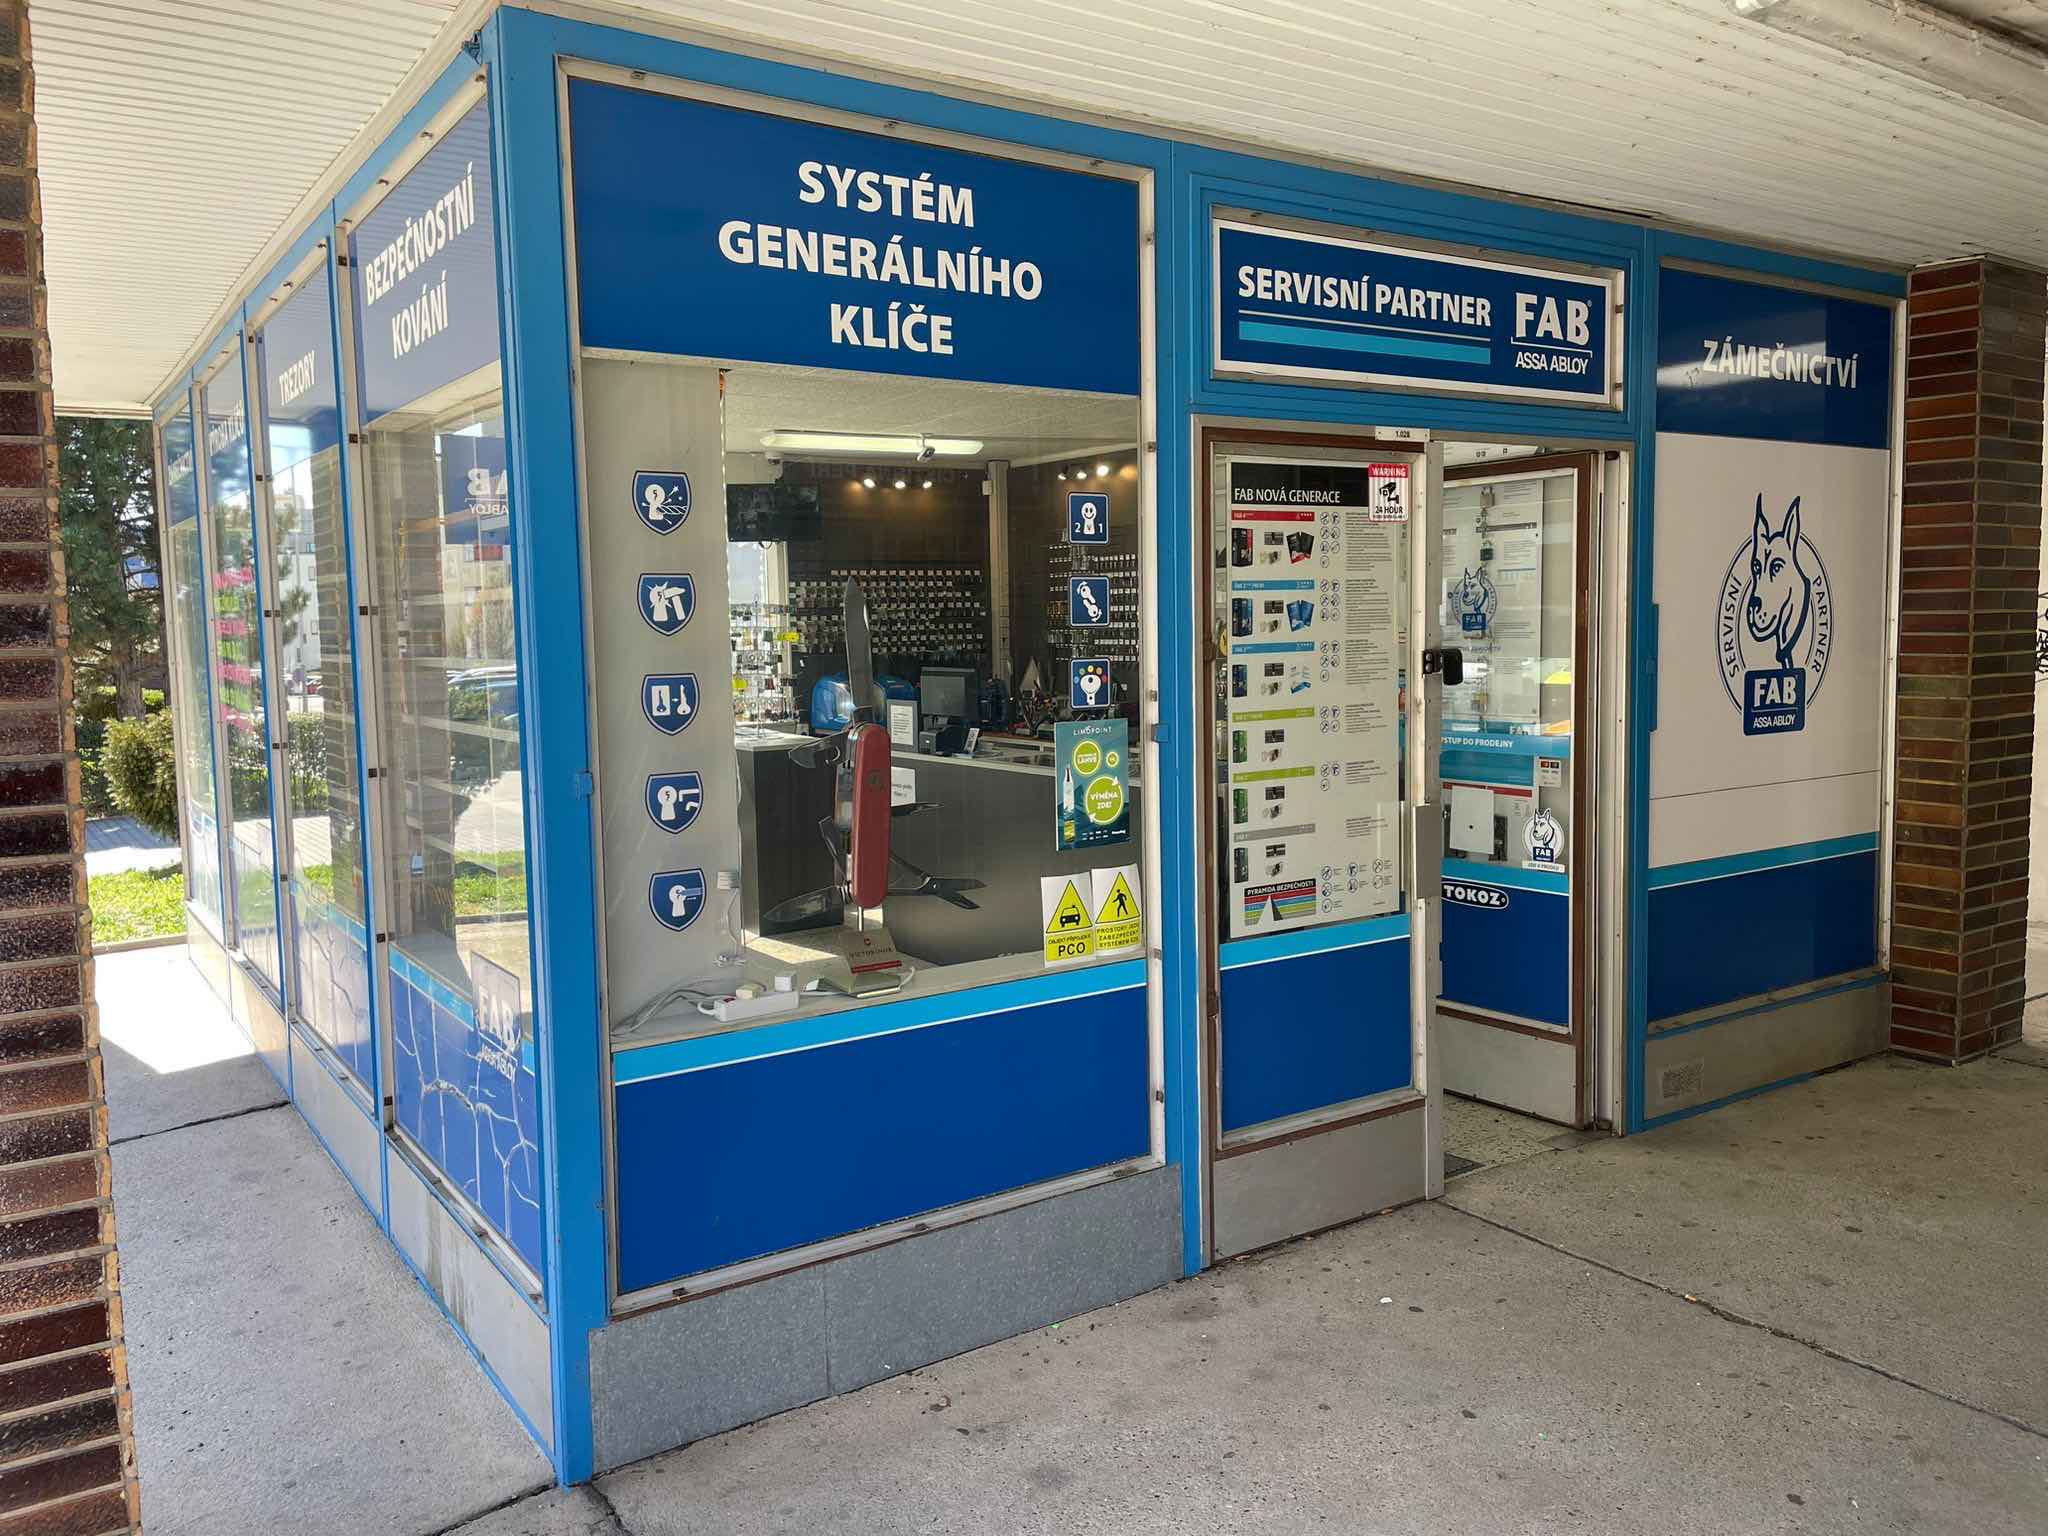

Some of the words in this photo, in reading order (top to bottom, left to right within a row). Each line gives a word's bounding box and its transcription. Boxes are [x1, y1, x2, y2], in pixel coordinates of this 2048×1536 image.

[798, 161, 974, 228] SYSTÉM
[365, 161, 475, 306] BEZPEČNOSTNÍ
[718, 220, 1043, 300] GENERÁLNÍHO
[391, 270, 449, 359] KOVÁNÍ
[1238, 265, 1370, 312] SERVISNÍ
[1375, 286, 1491, 327] PARTNER
[1515, 292, 1590, 345] FAB
[830, 302, 954, 355] KLÍČE
[279, 350, 316, 406] TREZORY
[1515, 351, 1548, 371] ASSA
[1550, 355, 1589, 375] ABLOY
[1703, 336, 1858, 389] ZÁMEČNICTVÍ
[1234, 488, 1254, 501] FAB
[1255, 486, 1287, 502] NOVÁ
[1289, 489, 1340, 503] GENERACE
[1371, 467, 1407, 477] WARNING
[1375, 506, 1383, 514] 24
[1384, 505, 1404, 514] HOUR
[1723, 574, 1743, 678] SERVISNÍ
[1812, 575, 1830, 673] PARTNER
[1754, 676, 1796, 707] FAB
[1475, 738, 1513, 748] PRODEJNY
[1752, 716, 1772, 728] ASSA
[1773, 714, 1796, 727] ABLOY
[1247, 886, 1276, 895] PYRAMIDA
[1443, 885, 1501, 906] TOKOZ
[1058, 942, 1086, 957] PCO
